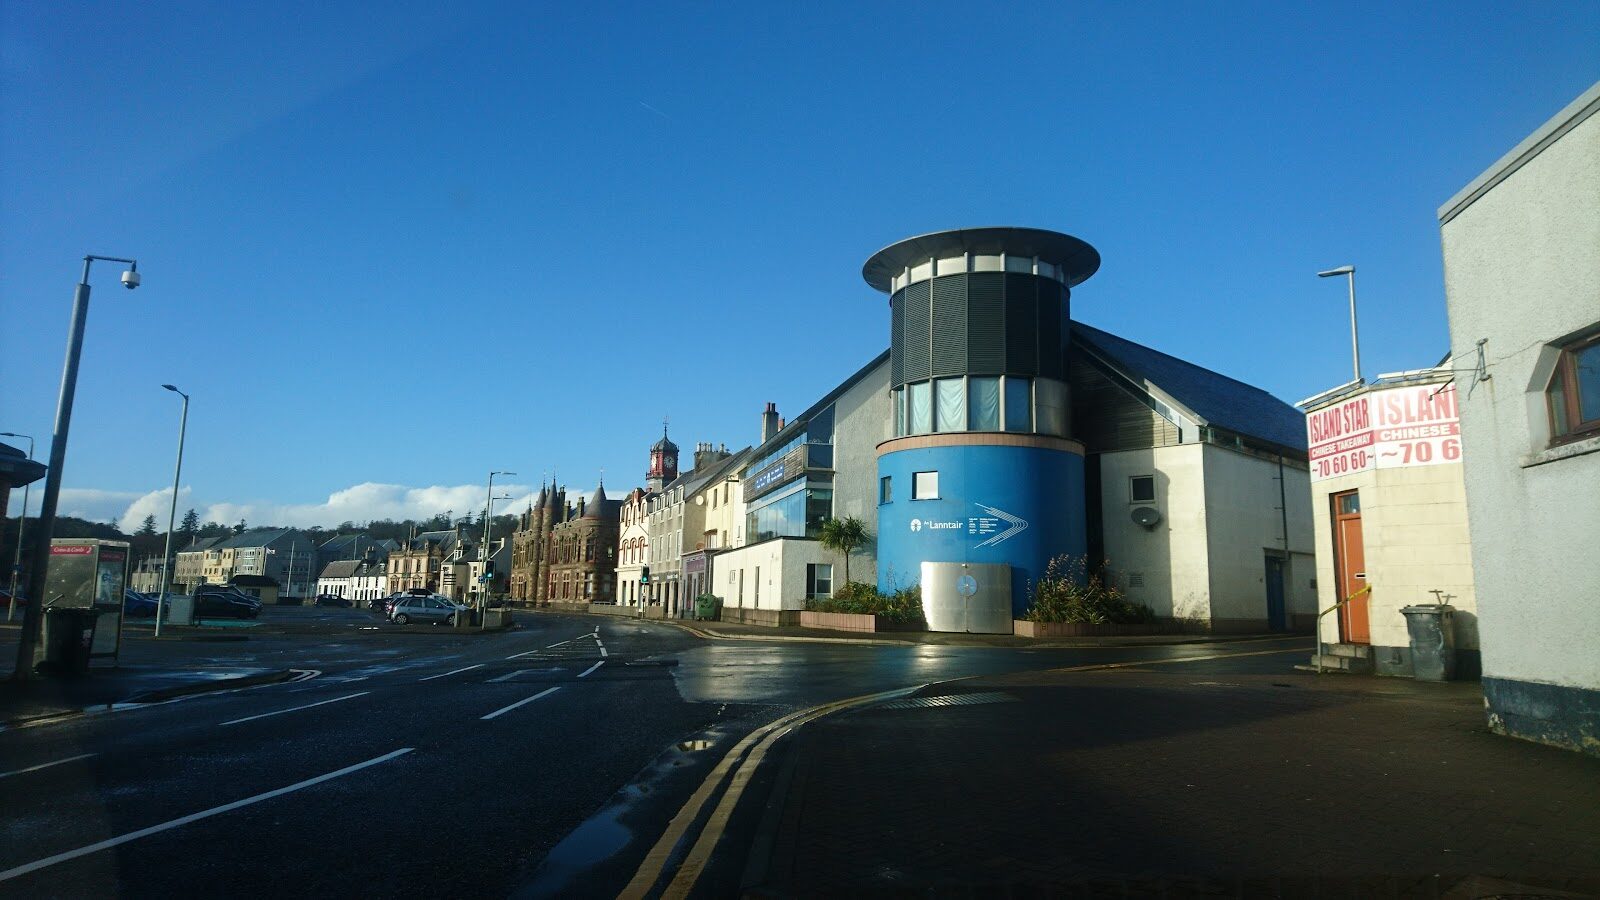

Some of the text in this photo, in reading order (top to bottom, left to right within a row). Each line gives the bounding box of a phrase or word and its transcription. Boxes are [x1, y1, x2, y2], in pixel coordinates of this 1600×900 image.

[1309, 398, 1370, 444] ISLAND STAR
[1380, 424, 1451, 441] CHINESE
[1312, 433, 1371, 458] CHINESE TAKEAWAY
[1333, 456, 1348, 474] 60
[930, 520, 964, 529] Lanntair
